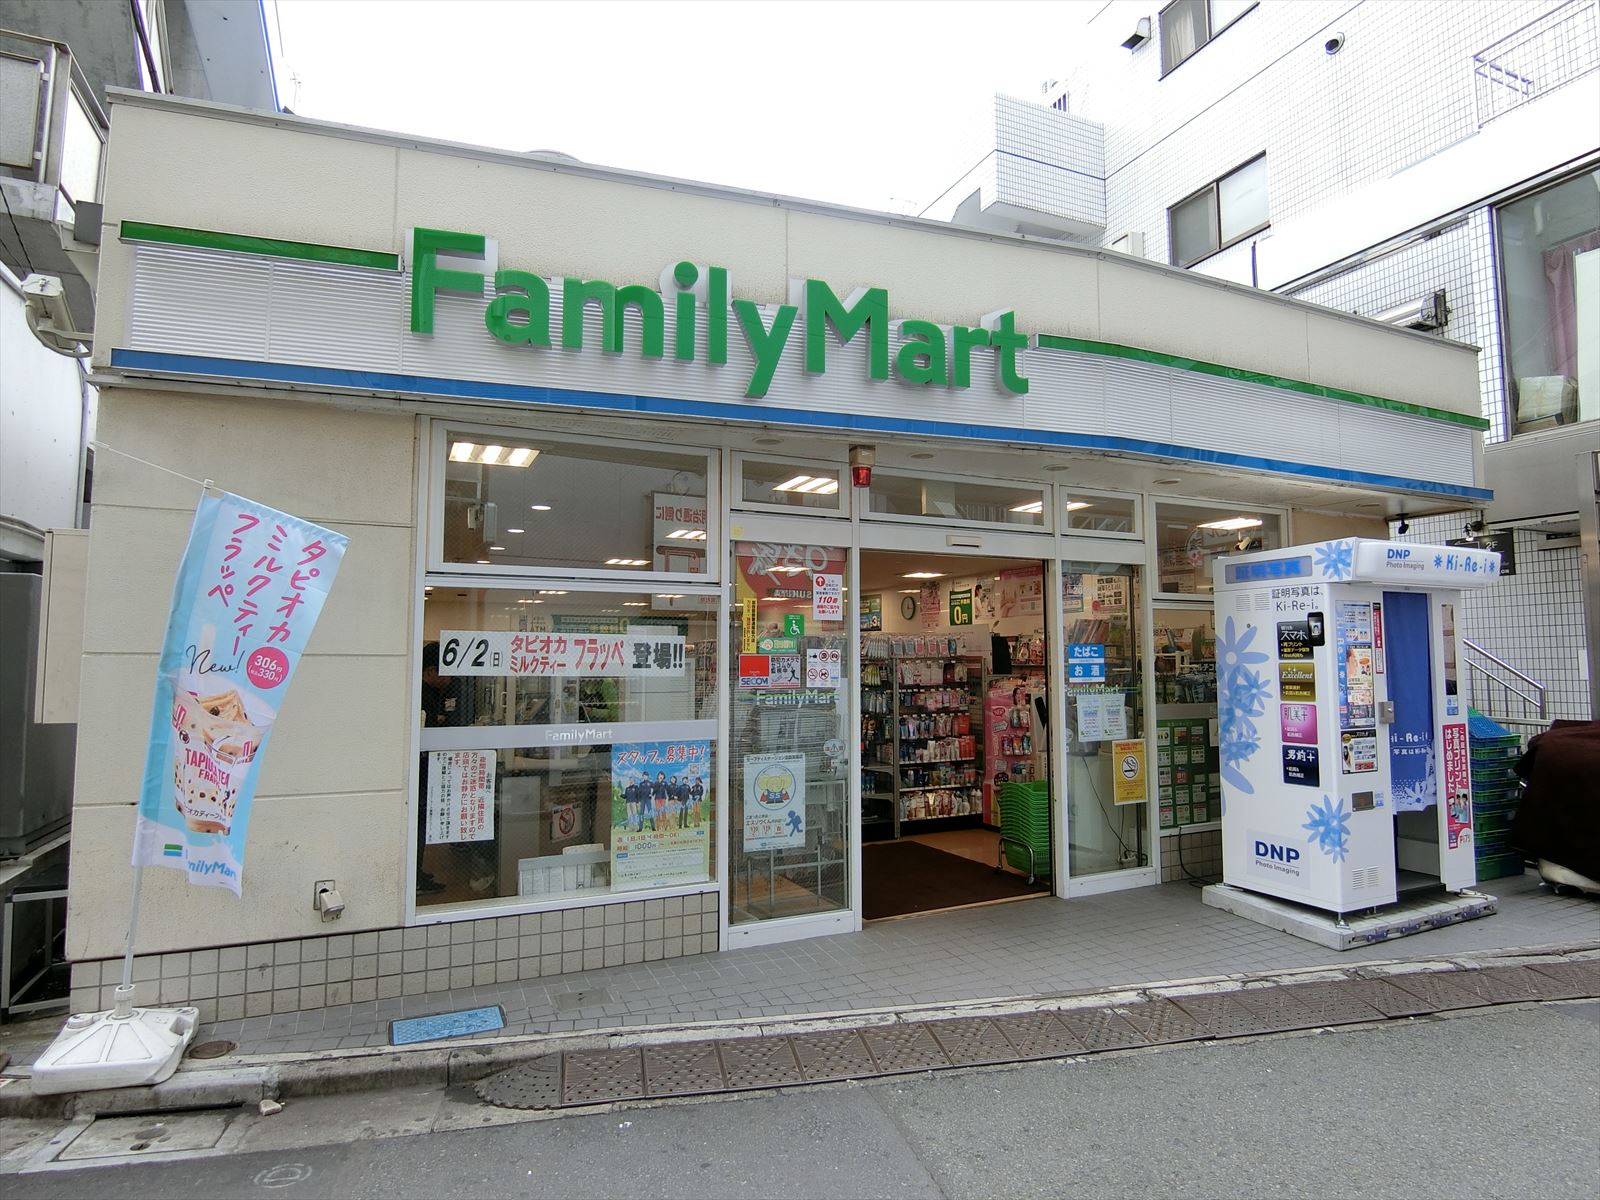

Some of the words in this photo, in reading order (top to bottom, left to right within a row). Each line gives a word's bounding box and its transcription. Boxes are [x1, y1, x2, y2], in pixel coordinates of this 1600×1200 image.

[411, 227, 1029, 398] FamilyMart
[208, 514, 260, 608] フラッペ
[1387, 549, 1410, 559] DNP
[1386, 561, 1402, 569] Photo
[1403, 562, 1424, 570] Imaging
[233, 525, 288, 656] ミルクティー
[268, 539, 326, 643] タピオカ
[1272, 586, 1323, 599] 証明写真は、
[510, 635, 568, 655] タピオカ
[1281, 630, 1309, 641] スマホ
[185, 644, 245, 675] New!
[574, 638, 625, 671] フラッペ
[632, 641, 683, 670] 登場!!
[1074, 646, 1098, 657] たばこ
[254, 655, 283, 672] 306円
[509, 656, 568, 675] ミルクティー
[1282, 671, 1313, 679] Excellent
[756, 689, 840, 708] FamilyMart
[545, 728, 613, 743] FamilyMart
[1445, 729, 1456, 793] はじめました
[1255, 841, 1300, 863] DNP
[1255, 859, 1273, 870] Photo
[1273, 863, 1300, 876] Imaging
